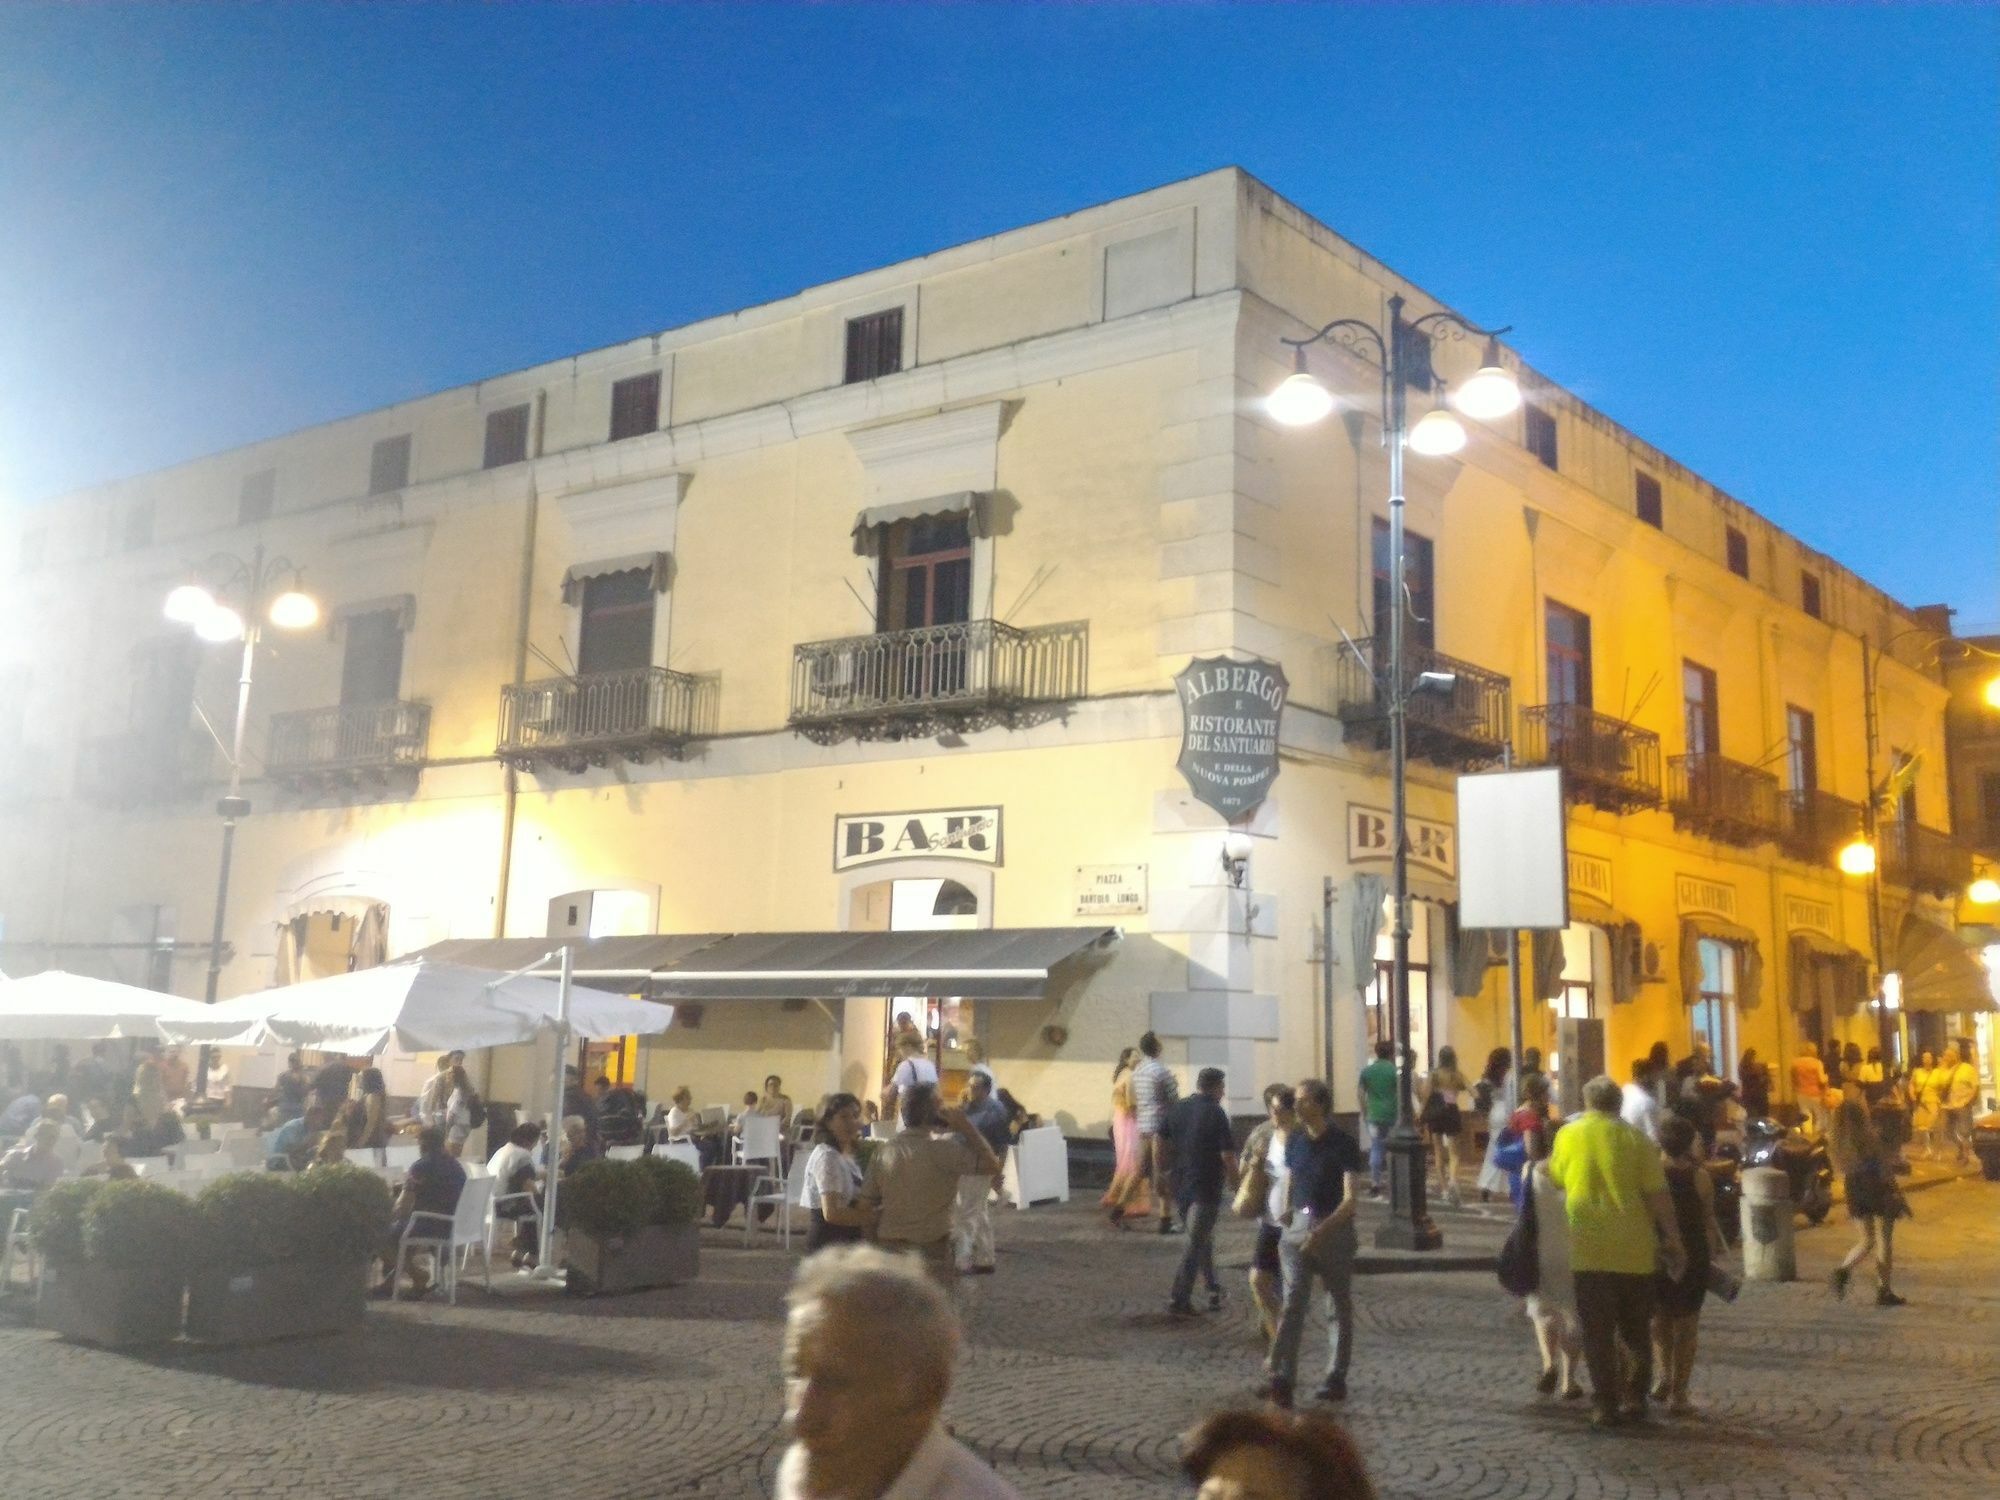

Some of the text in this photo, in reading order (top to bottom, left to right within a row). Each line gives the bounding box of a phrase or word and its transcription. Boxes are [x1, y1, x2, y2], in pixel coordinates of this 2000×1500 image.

[1185, 667, 1282, 712] ALBERGO
[1235, 700, 1242, 710] E
[1189, 714, 1277, 736] RISTORANTE
[1187, 734, 1275, 755] DEL SANTUARIO
[1192, 761, 1270, 786] NUOVA POMPEI
[1214, 762, 1252, 773] E DELLA
[842, 815, 991, 858] BAR
[1096, 874, 1122, 885] PIAZZA
